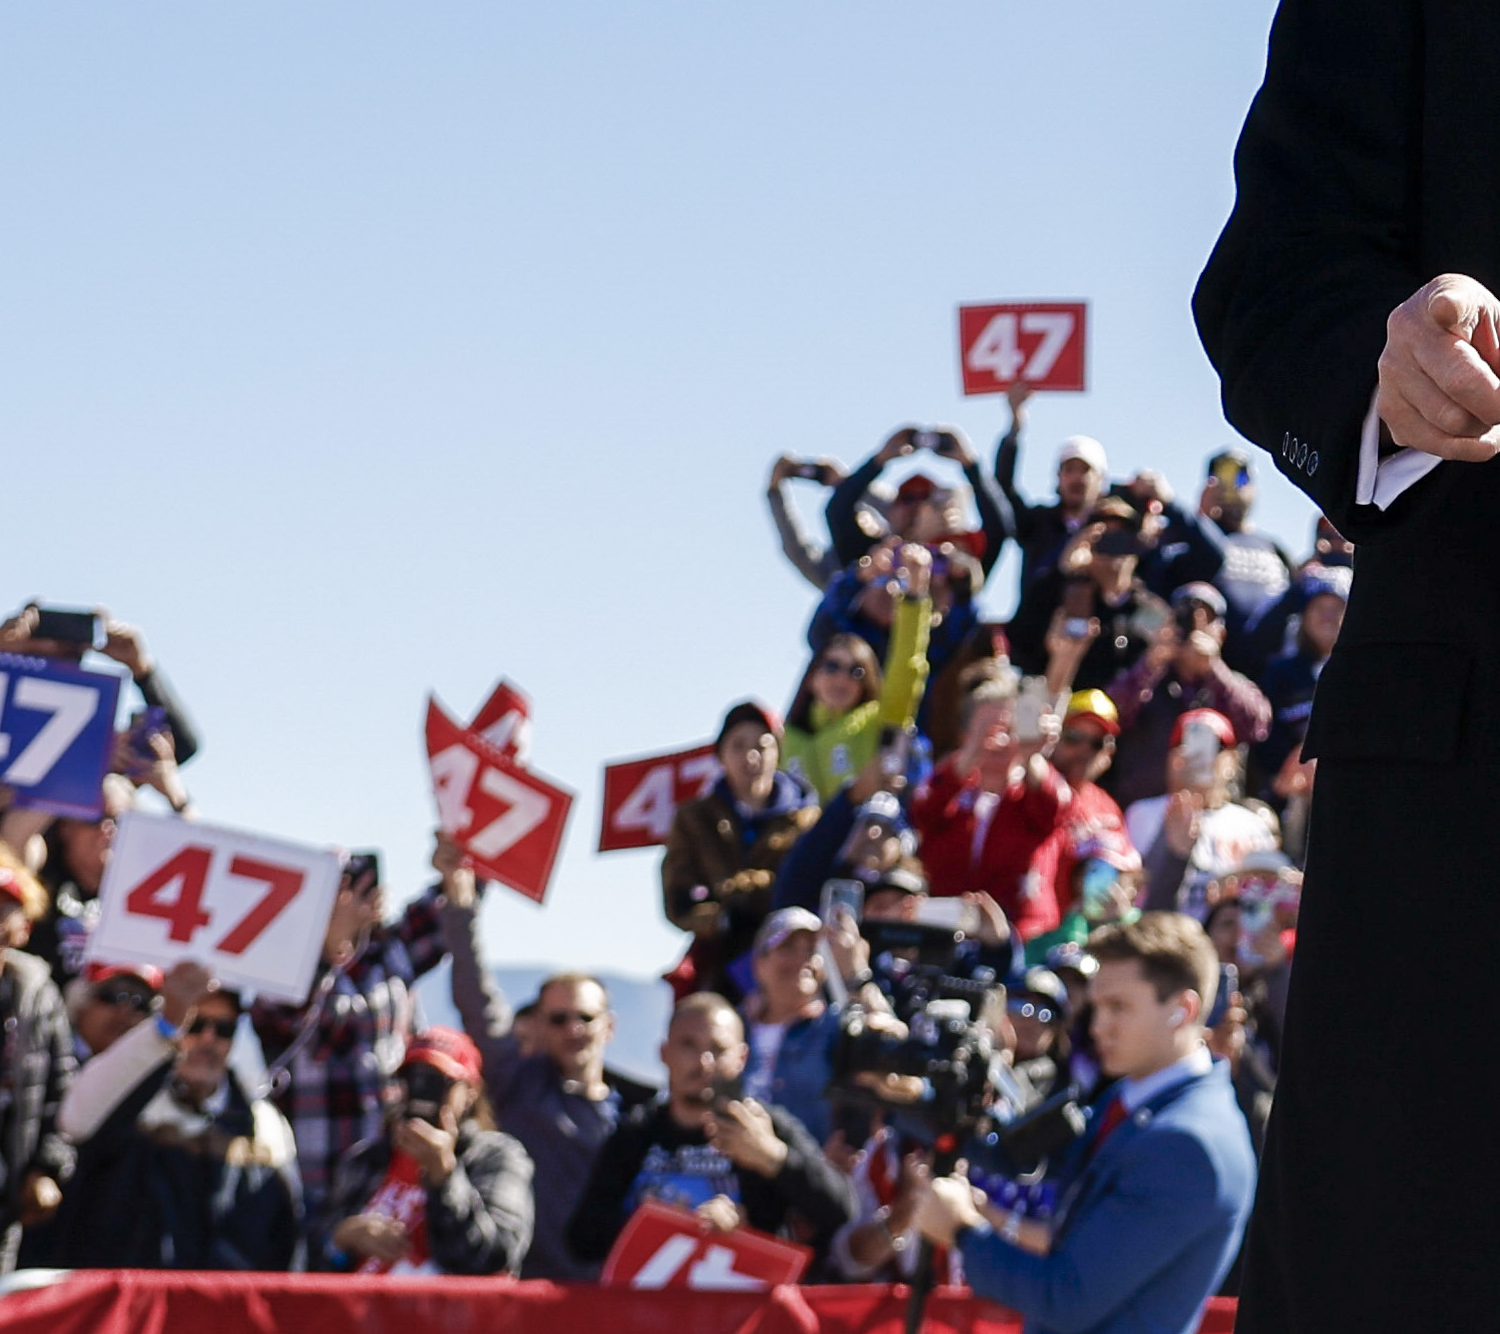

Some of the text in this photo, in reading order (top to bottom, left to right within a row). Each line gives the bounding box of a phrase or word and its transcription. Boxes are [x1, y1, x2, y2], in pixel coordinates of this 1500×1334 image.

[967, 313, 1075, 381] 47
[430, 742, 552, 861] 47
[125, 843, 305, 957] 47
